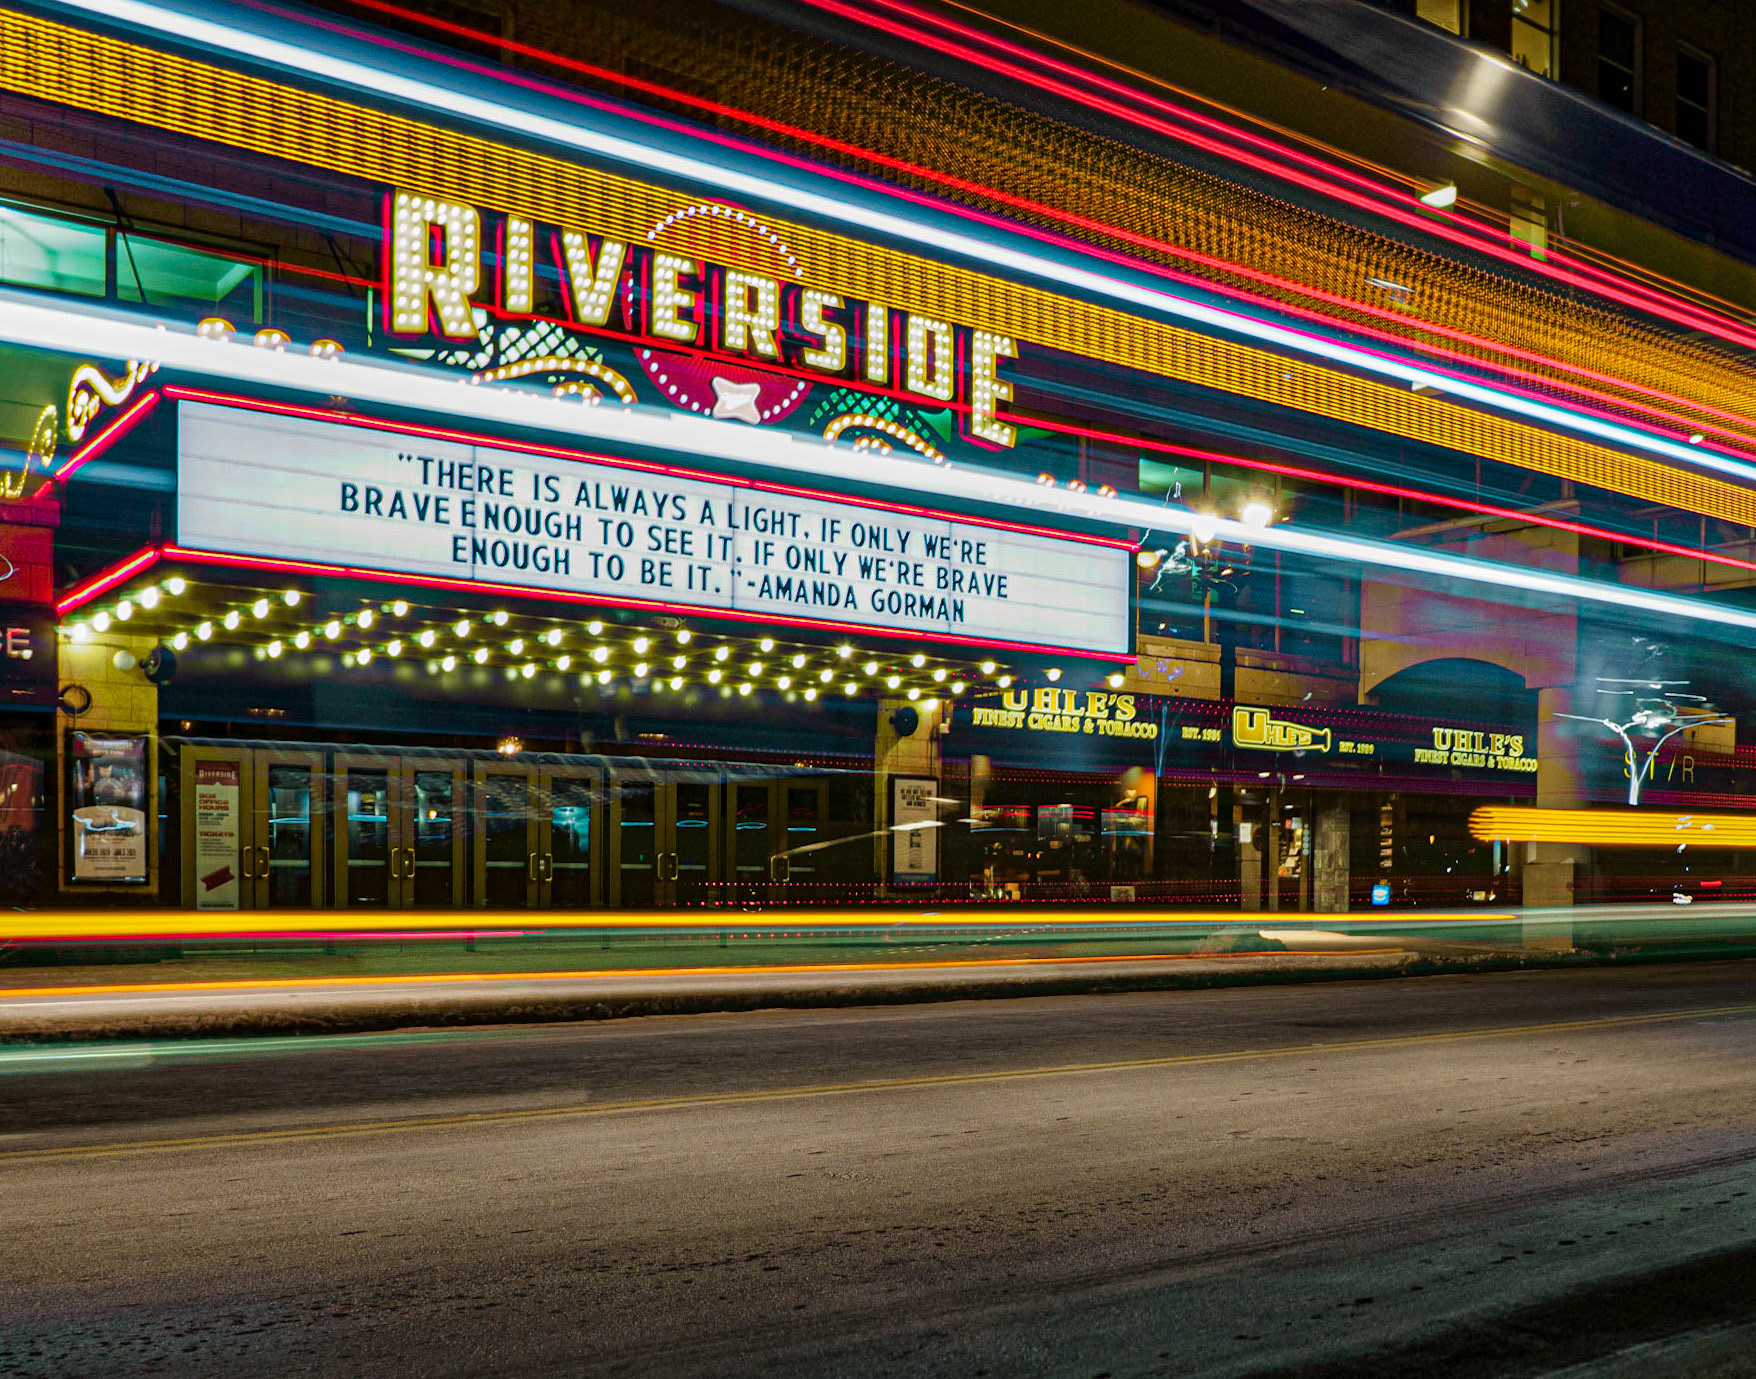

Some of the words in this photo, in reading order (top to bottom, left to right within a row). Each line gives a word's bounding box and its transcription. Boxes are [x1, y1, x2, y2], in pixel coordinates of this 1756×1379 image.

[392, 187, 1019, 449] RIVERSIDE
[533, 473, 561, 502] IS
[575, 481, 687, 521] ALWAYS
[699, 499, 715, 526] A
[727, 502, 810, 540] LIGHT,
[821, 517, 841, 544] IF
[850, 522, 911, 554] ONLY
[923, 532, 987, 565] WE'RE
[340, 482, 451, 525] BRAVE
[460, 499, 582, 542] ENOUGH
[597, 518, 635, 548] TO
[647, 525, 693, 556] SEE
[707, 533, 743, 564] IT.
[753, 539, 775, 567] IF
[785, 544, 848, 576] ONLY
[858, 554, 925, 588] WE'RE
[936, 566, 1009, 599] BRAVE
[452, 535, 570, 576] ENOUGH
[588, 551, 625, 581] TO
[640, 558, 673, 587] BE
[870, 588, 965, 624] GORMAN
[1002, 687, 1138, 722] UHLE'S
[972, 707, 1026, 729] FINEST
[1027, 712, 1081, 733] CIGARS
[1082, 718, 1095, 735] &
[1096, 718, 1159, 740] TOBACCO
[1236, 710, 1313, 746] UHLE'S
[1432, 726, 1524, 757] UHLE'S
[1414, 748, 1450, 765] FINEST
[1450, 751, 1486, 767] CIGARS
[1486, 755, 1496, 769] &
[1496, 756, 1538, 773] TOBACCO
